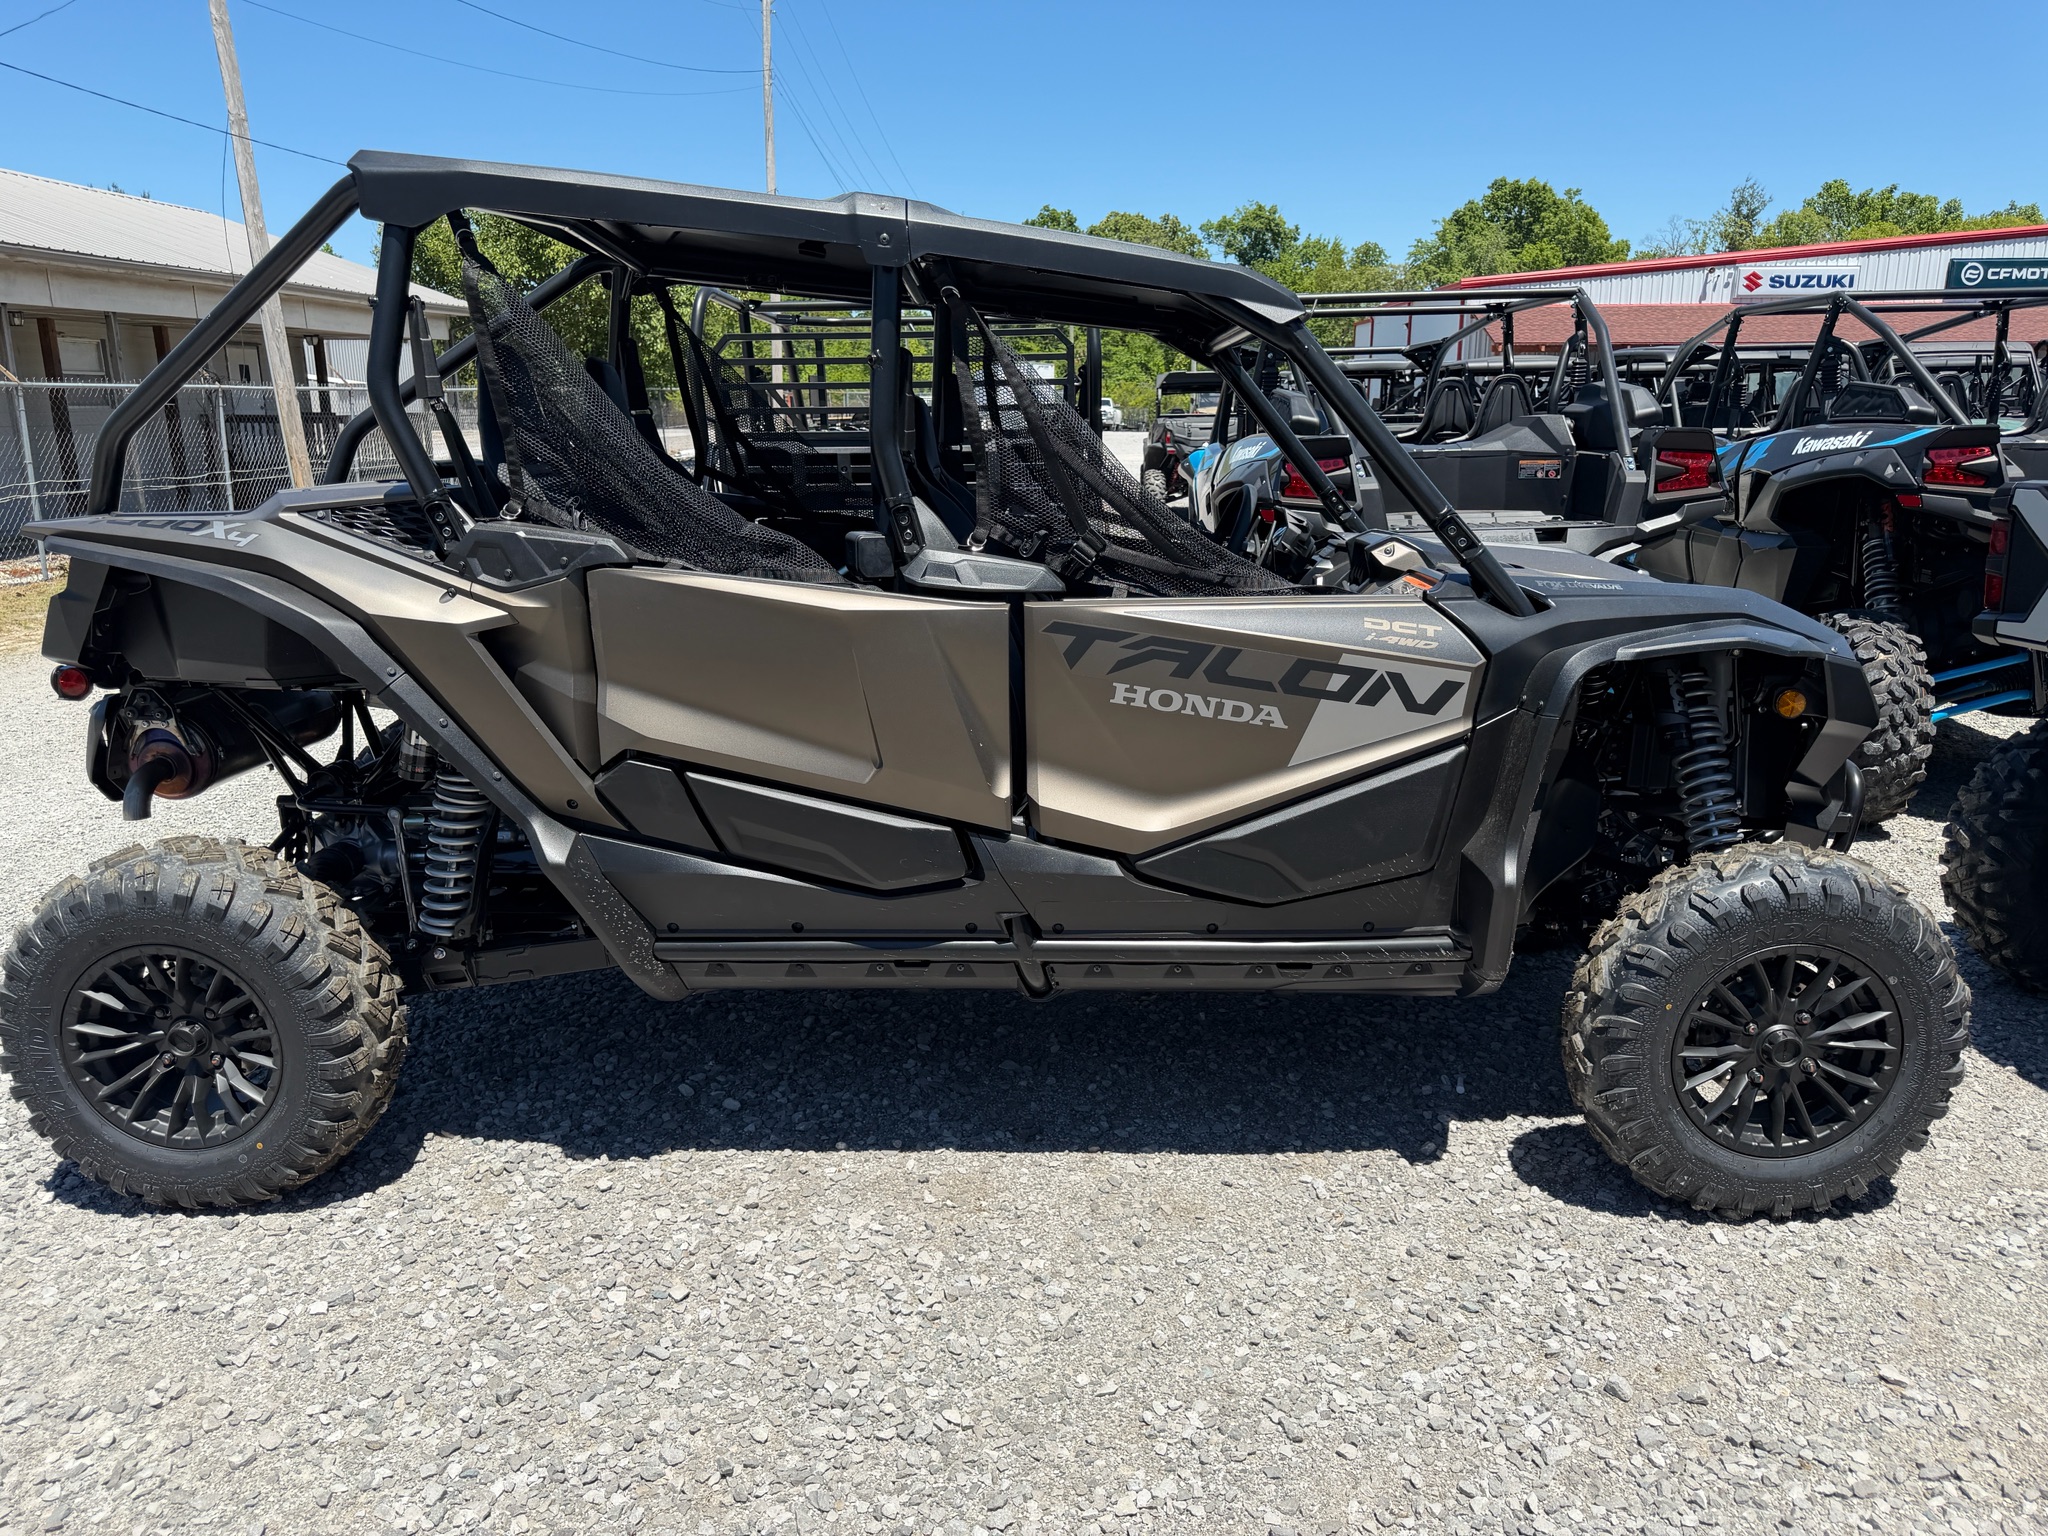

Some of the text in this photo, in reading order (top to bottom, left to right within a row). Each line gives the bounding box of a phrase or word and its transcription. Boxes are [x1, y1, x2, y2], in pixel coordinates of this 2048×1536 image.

[1768, 273, 1855, 289] SUZUKI
[1791, 431, 1873, 455] Kawasaki
[1363, 617, 1443, 637] DCT
[1364, 632, 1440, 649] i-4WD
[1041, 620, 1466, 717] TALON
[1109, 682, 1289, 730] HONDA
